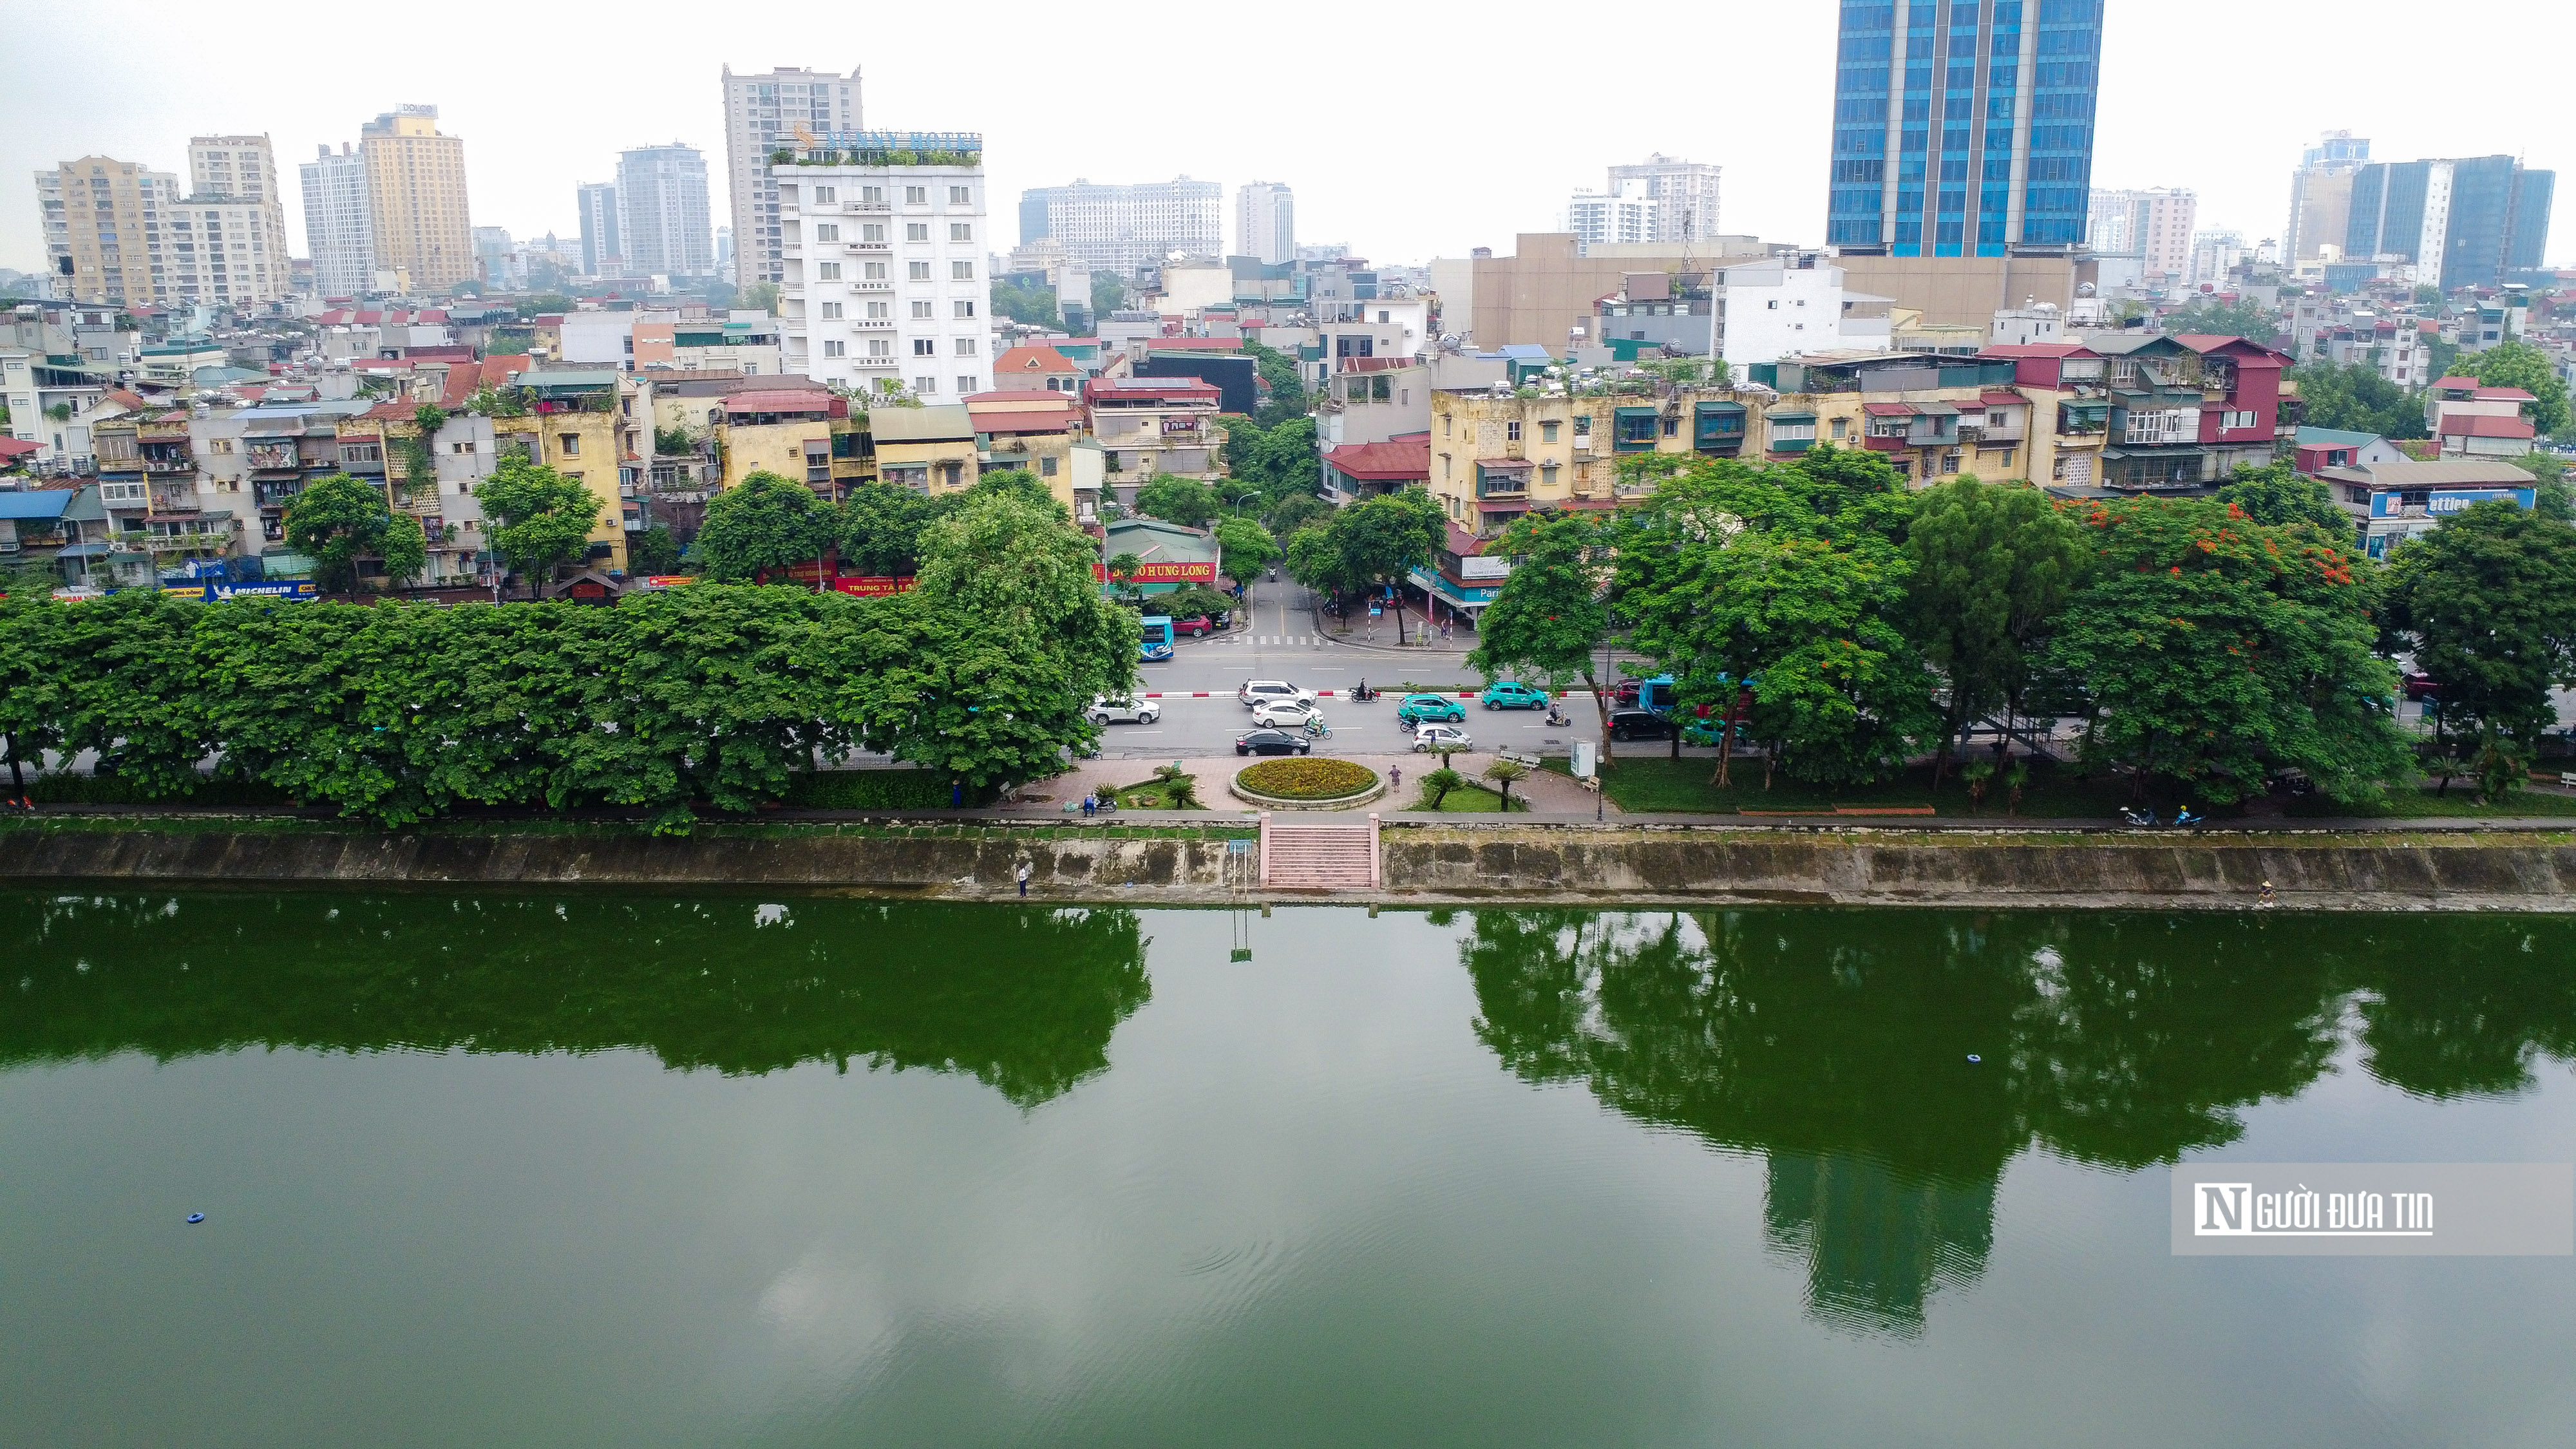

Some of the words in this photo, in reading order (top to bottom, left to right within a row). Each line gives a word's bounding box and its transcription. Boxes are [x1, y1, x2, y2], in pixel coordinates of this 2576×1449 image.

[827, 131, 898, 150] SUNNY
[909, 132, 982, 151] HOTEL
[1180, 565, 1210, 576] LONG
[235, 586, 292, 596] MICHELIN
[1481, 588, 1502, 598] Pari
